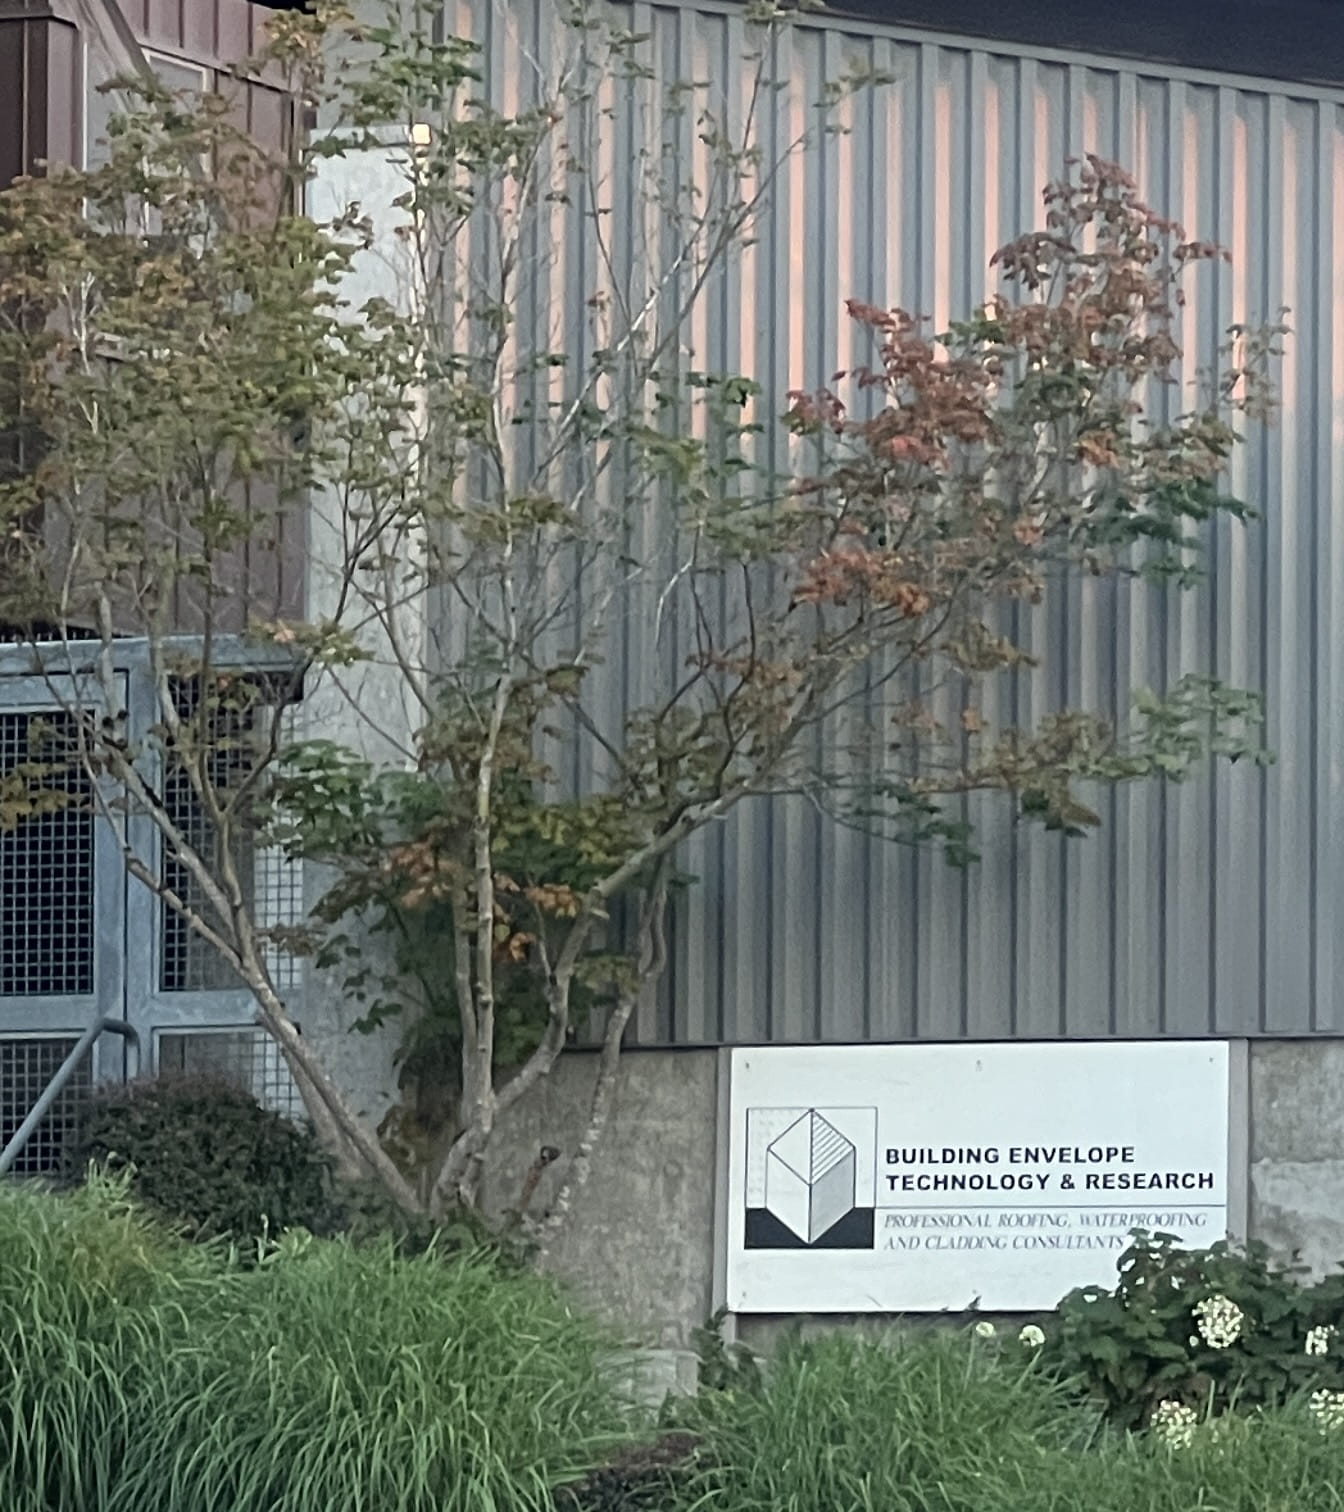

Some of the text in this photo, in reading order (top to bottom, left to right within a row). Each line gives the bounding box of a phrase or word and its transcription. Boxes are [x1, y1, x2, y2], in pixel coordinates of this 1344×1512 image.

[886, 1146, 1135, 1164] BUILDING ENVELOPE
[886, 1172, 1214, 1191] TECHNOLOGY & RESEARCH
[884, 1213, 992, 1229] PROFESSIONAL
[1080, 1212, 1208, 1228] WATERPROOFING
[883, 1235, 1126, 1250] AND CLADDING CONSULTANTS
